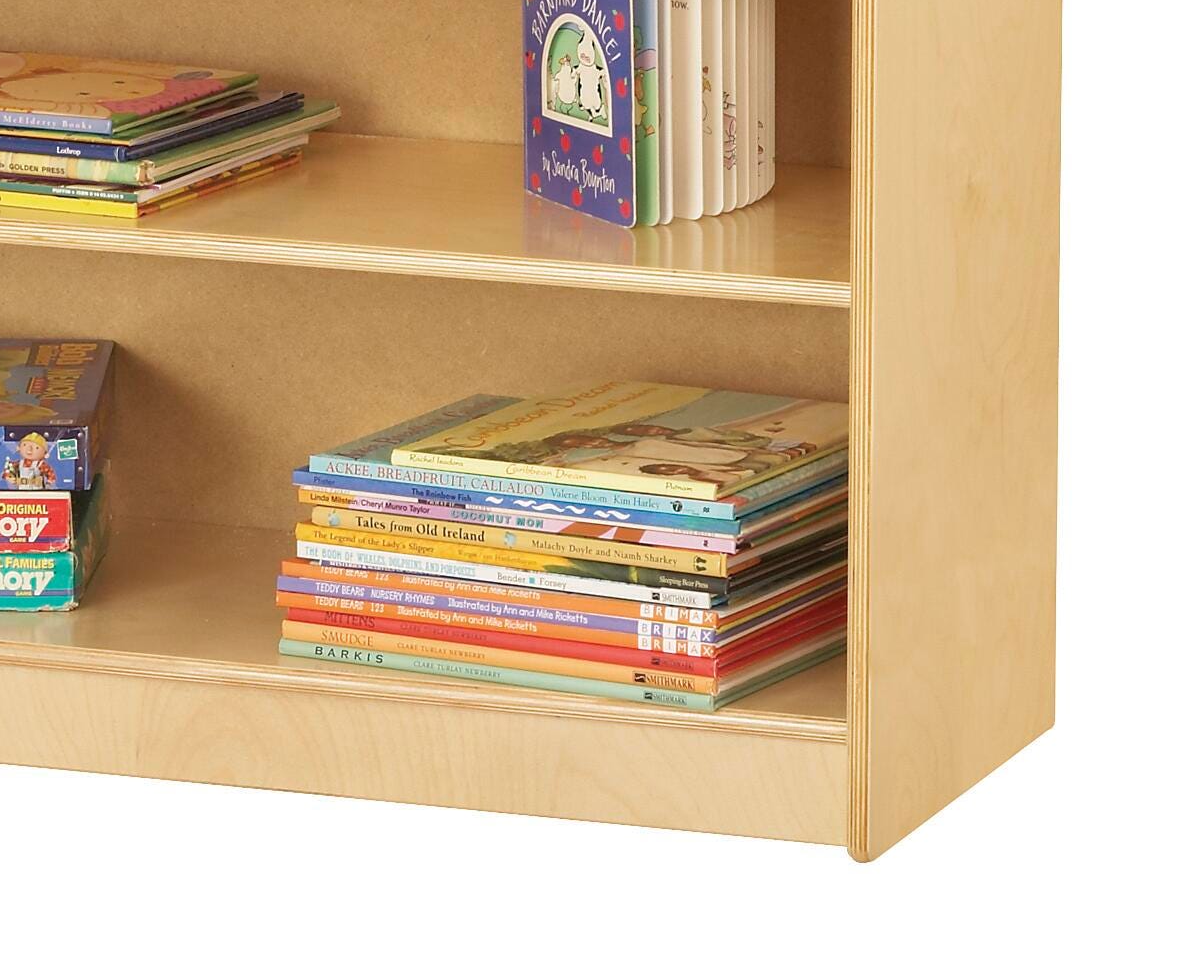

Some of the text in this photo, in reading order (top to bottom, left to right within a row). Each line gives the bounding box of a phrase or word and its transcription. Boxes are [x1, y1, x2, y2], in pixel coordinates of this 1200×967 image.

[56, 146, 81, 156] Lothrop
[8, 163, 66, 175] GOLDEN PRESS
[541, 149, 615, 200] by Sandra Boynton
[326, 461, 373, 477] ACKEE,
[377, 466, 467, 489] BREADFRUIT,
[471, 477, 544, 497] CALLALOO
[550, 487, 579, 501] Valerie
[581, 490, 608, 504] Bloom
[613, 492, 632, 505] Kim
[310, 493, 330, 502] Linda
[360, 498, 384, 510] Cheryl
[385, 502, 408, 512] Munro
[409, 505, 431, 515] Taylor
[451, 510, 512, 525] COCONUT
[515, 517, 544, 528] MON
[355, 515, 678, 568] Tales from Old Ireland Malachy Doyle and Niamh Sharkey
[5, 556, 55, 569] FAMILIES
[315, 582, 712, 642] TEDDY BEARS NURSERY RHYMES Illustrated by Ann and Mike Ricketts BRIMAX
[324, 611, 376, 628] MITTENS
[314, 646, 384, 664] BARKIS
[320, 629, 694, 690] SMUDGE SMITHMARK
